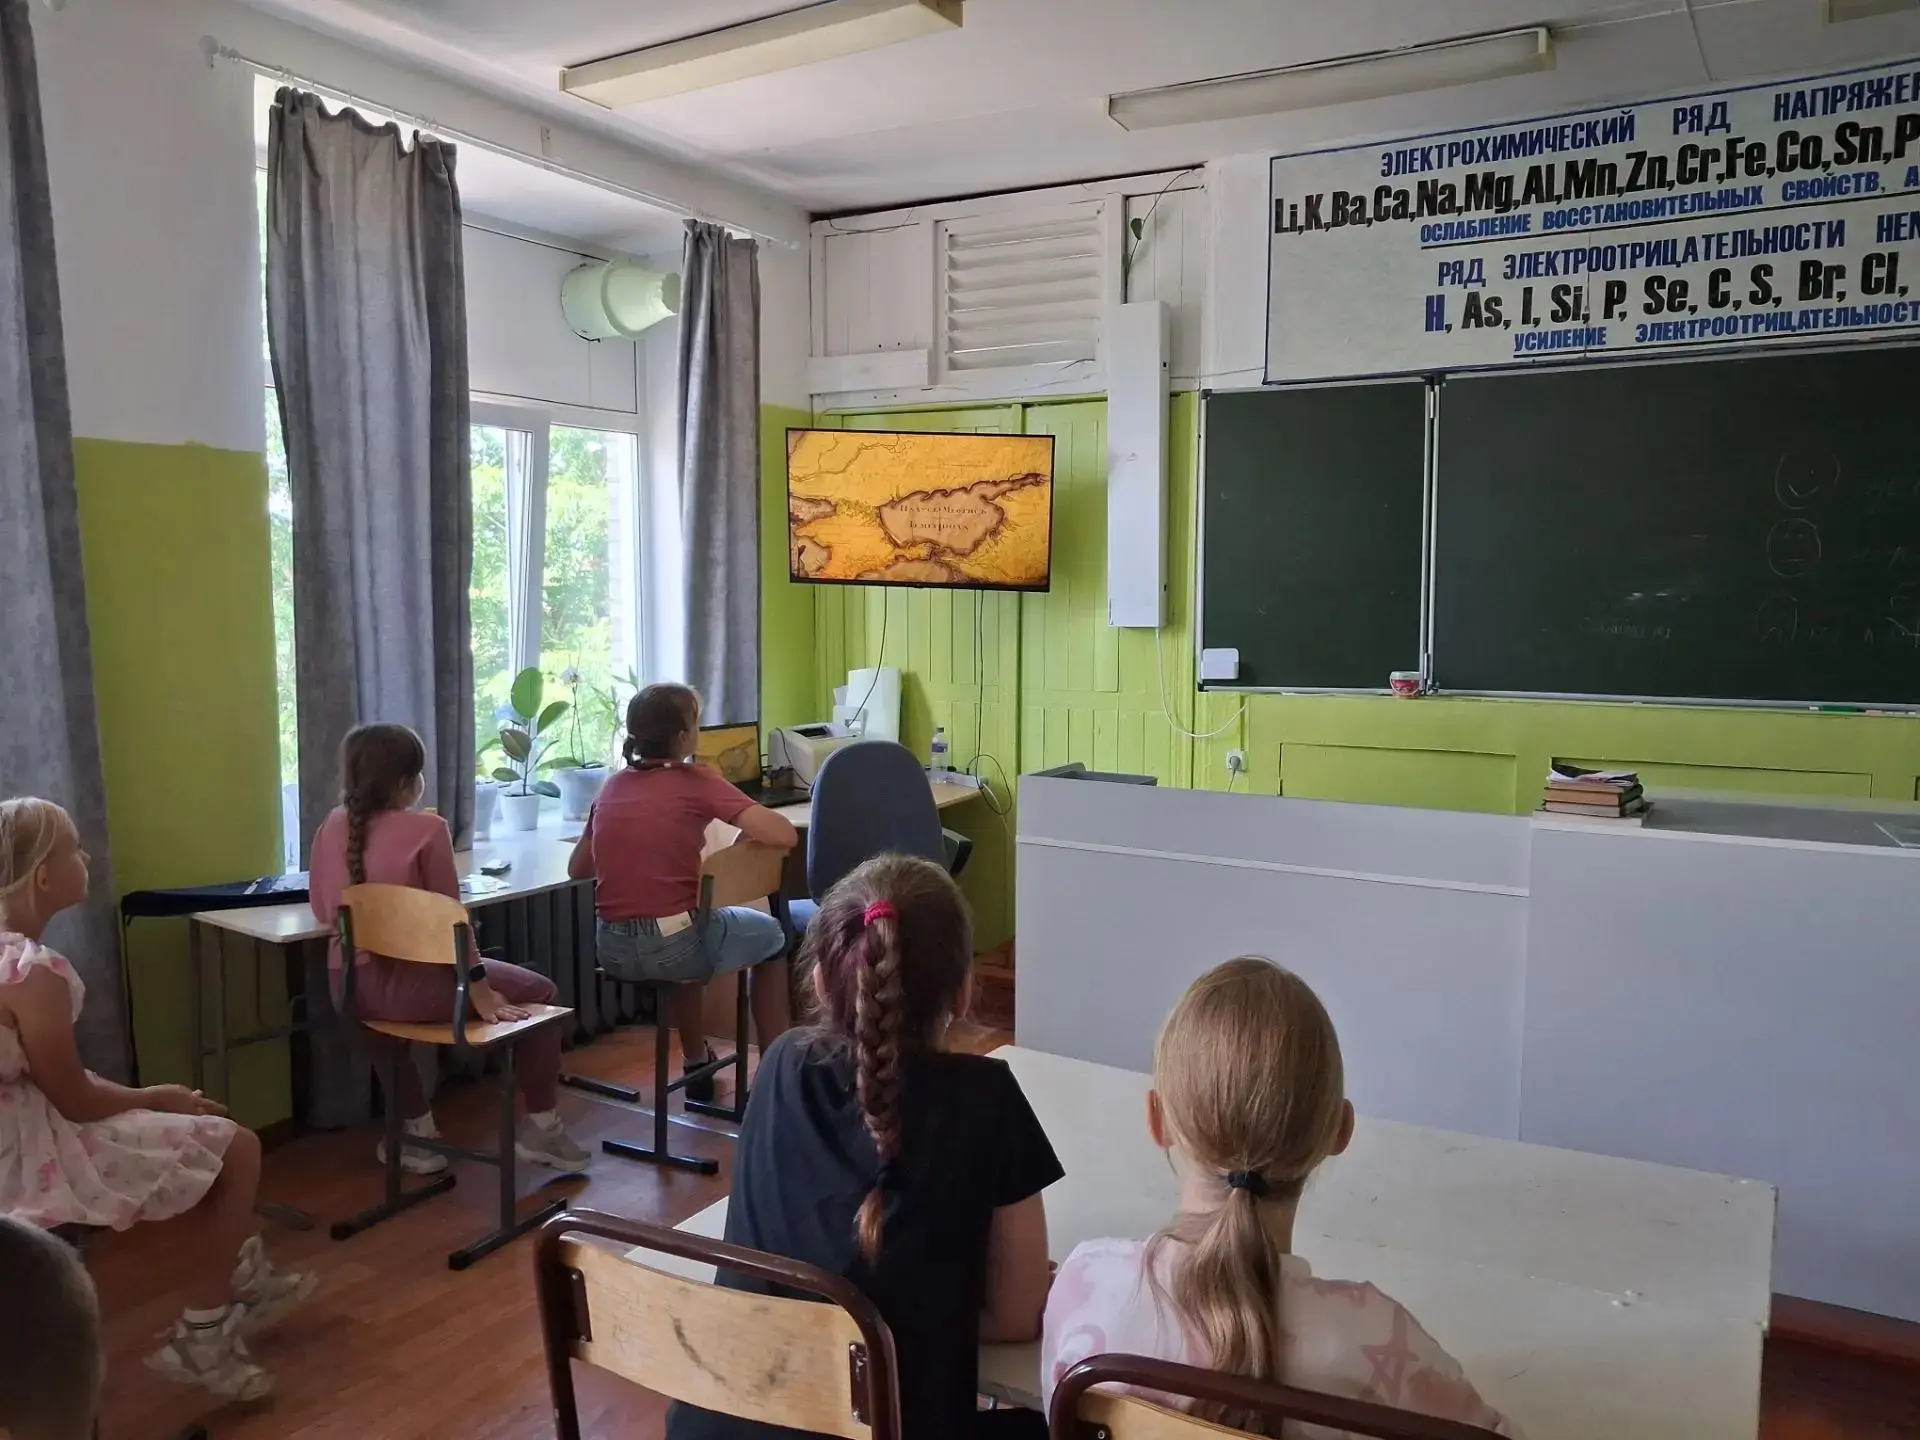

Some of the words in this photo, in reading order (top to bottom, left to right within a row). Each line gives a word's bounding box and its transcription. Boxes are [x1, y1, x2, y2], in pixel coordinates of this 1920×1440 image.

[1381, 110, 1635, 177] ЭЛЕКТРОХИМИЧЕСКИЙ
[1673, 101, 1731, 136] РЯД
[1420, 213, 1532, 244] ОСЛАБЛЕНИЕ
[1543, 185, 1763, 230] ВОССТАНОВИТЕЛЬНЫХ
[1781, 171, 1885, 202] СВОЙСТВ,
[1438, 257, 1487, 289] РЯД
[1503, 219, 1845, 280] ЭЛЕКТРООТРИЦАТЕЛЬНОСТИ
[1424, 294, 1452, 334] H,
[1461, 291, 1511, 330] As,
[1550, 284, 1590, 324] Si,
[1603, 279, 1628, 321] P,
[1643, 275, 1698, 315] Se,
[1708, 268, 1742, 312] C,
[1750, 263, 1783, 308] S,
[1798, 259, 1846, 303] Br,
[1861, 252, 1909, 298] Cl,
[1514, 325, 1606, 351] УСИЛЕНИЕ
